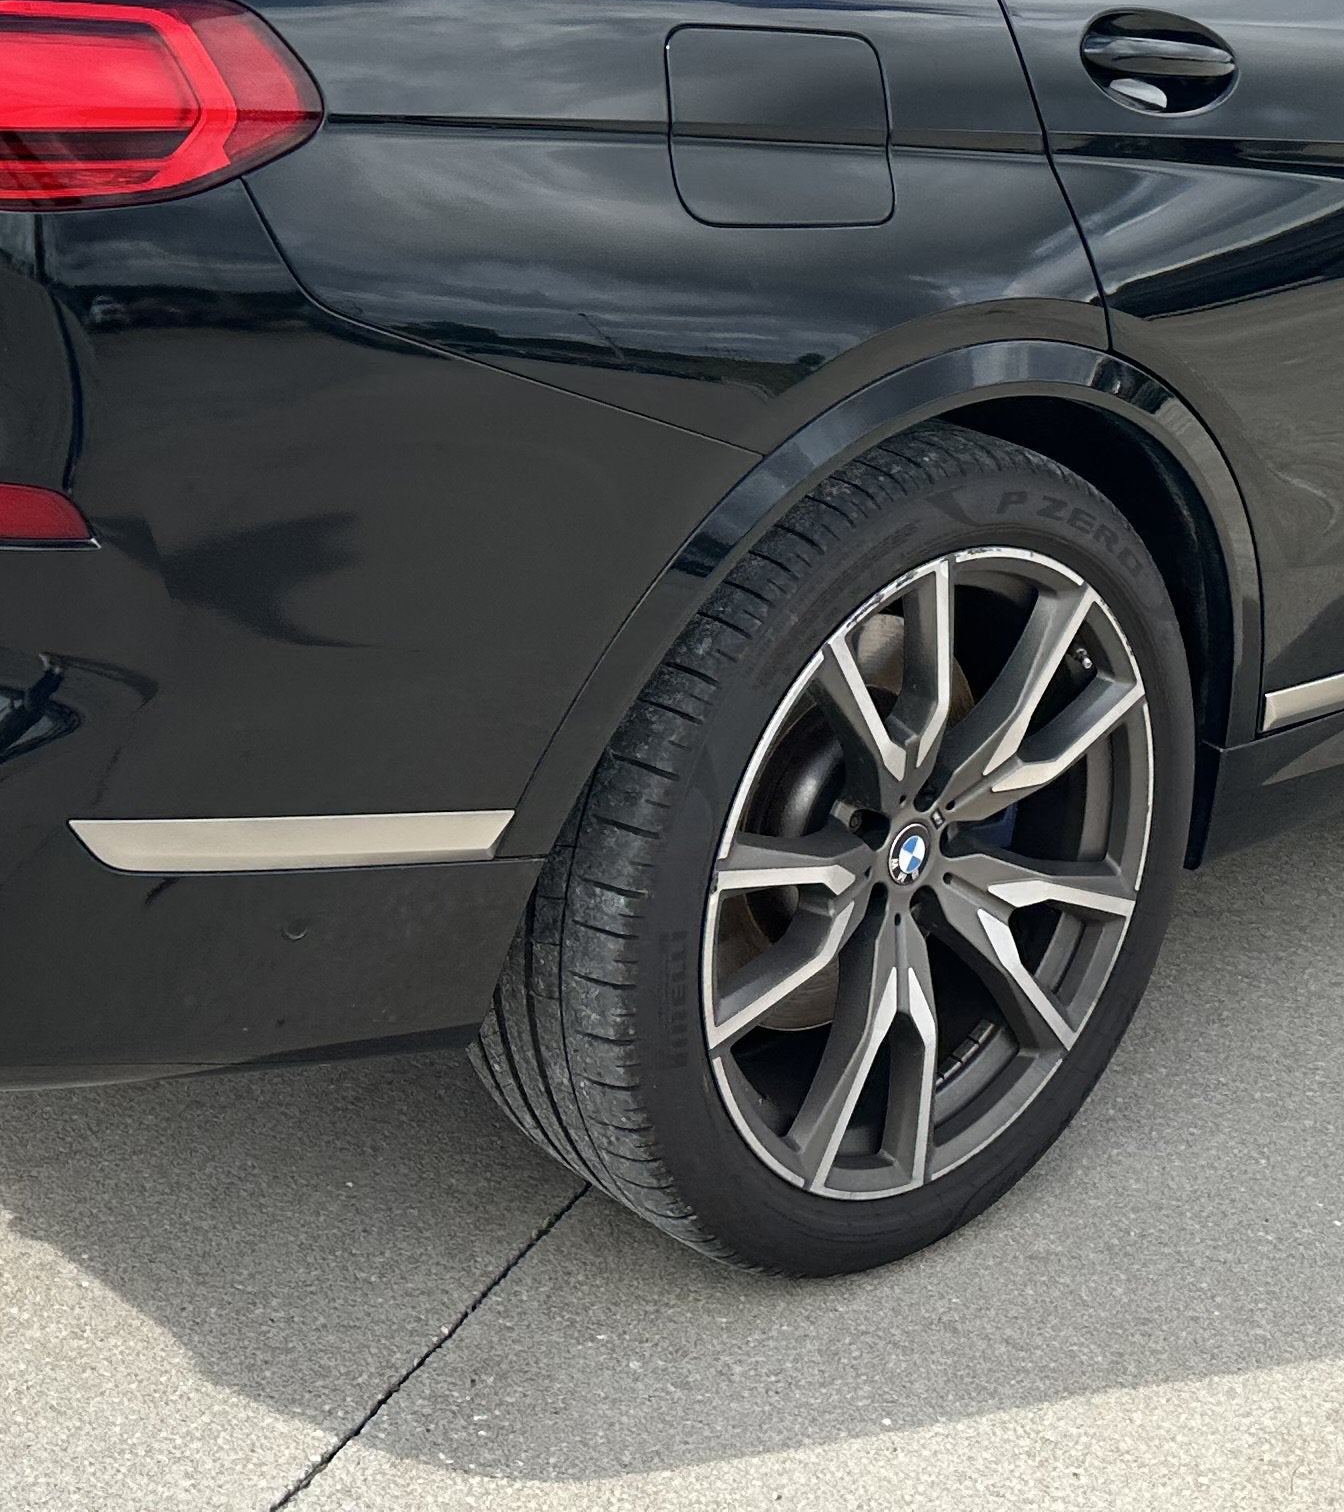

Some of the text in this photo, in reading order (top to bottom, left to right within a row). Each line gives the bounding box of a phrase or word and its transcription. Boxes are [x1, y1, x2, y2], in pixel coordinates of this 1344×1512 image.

[996, 491, 1144, 577] P ZERO
[891, 858, 920, 883] BMW
